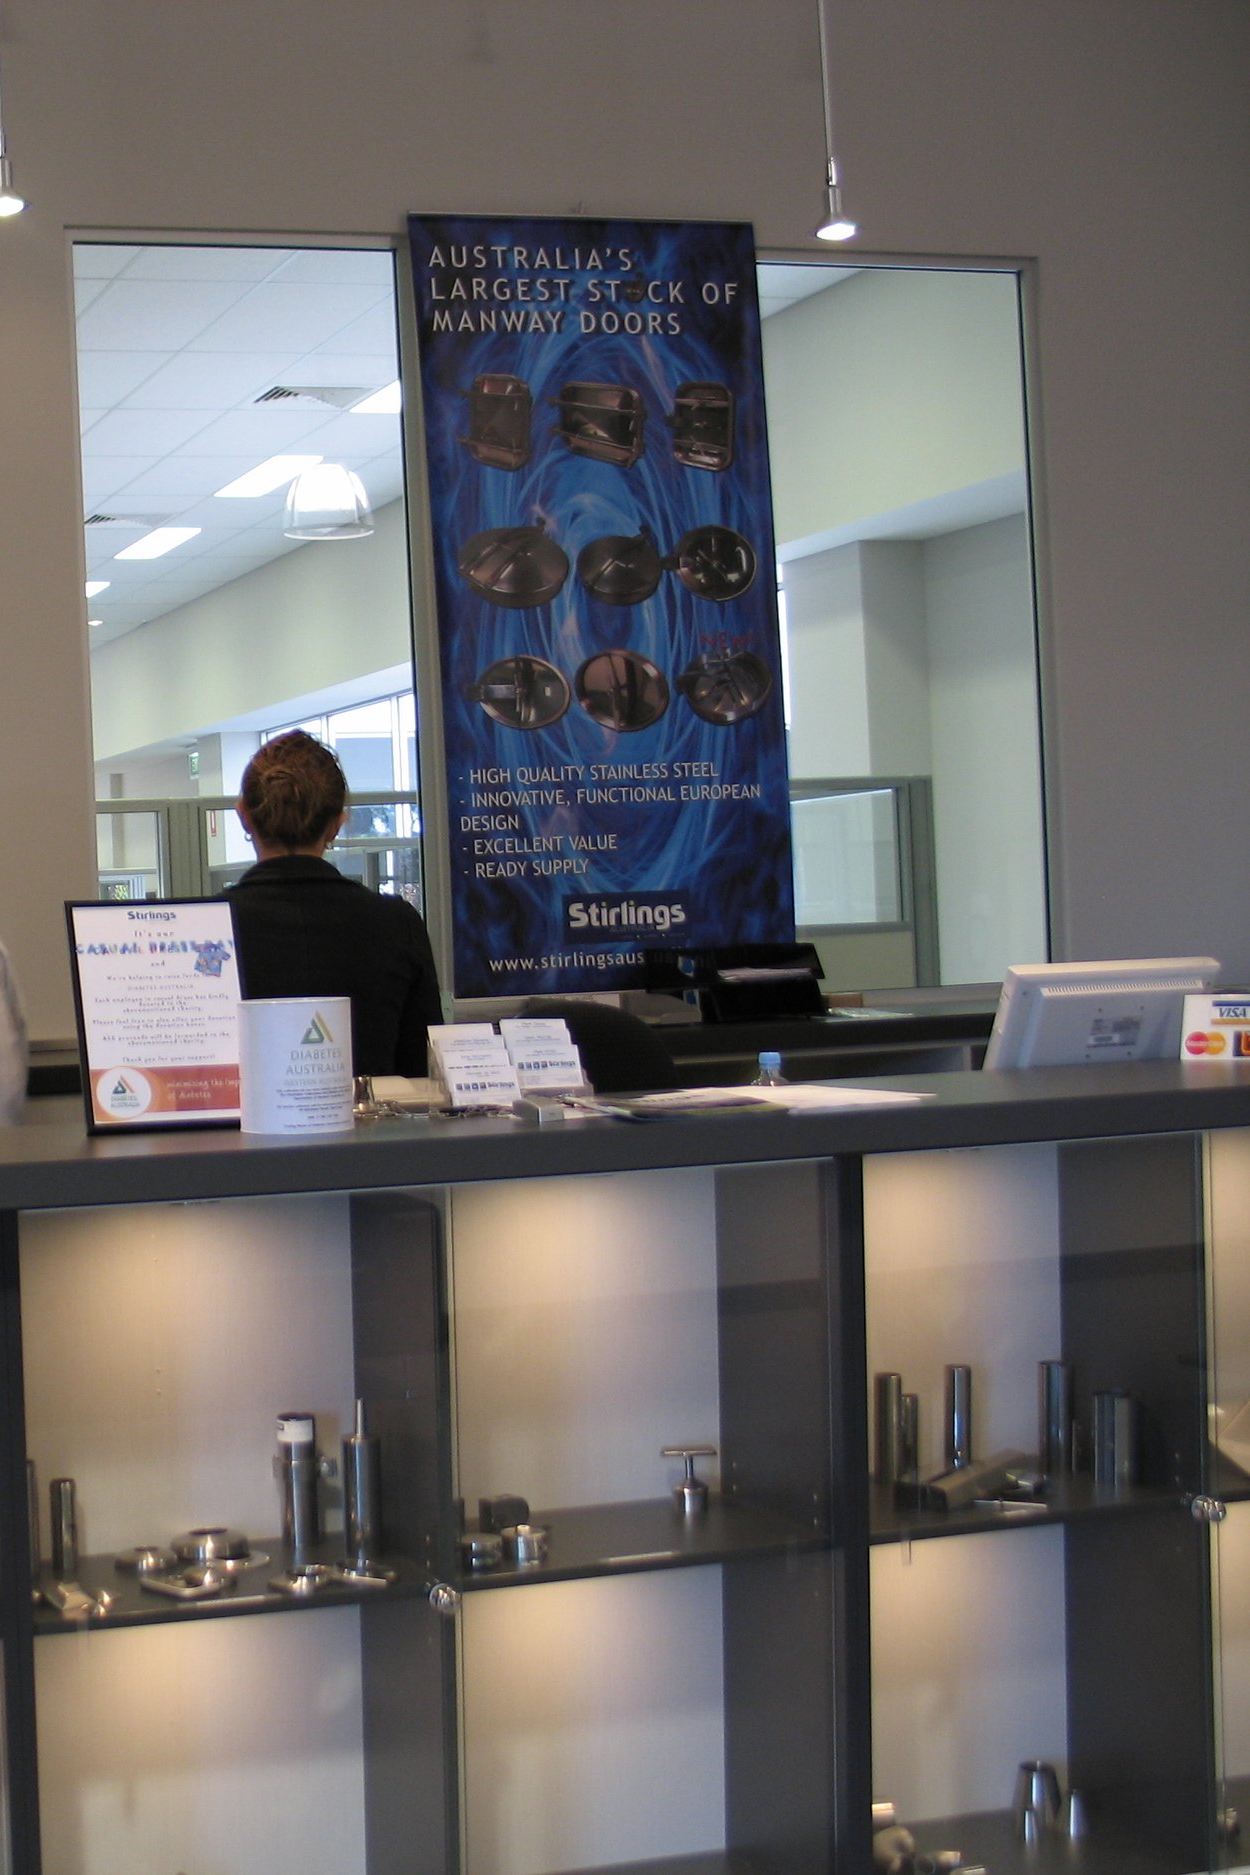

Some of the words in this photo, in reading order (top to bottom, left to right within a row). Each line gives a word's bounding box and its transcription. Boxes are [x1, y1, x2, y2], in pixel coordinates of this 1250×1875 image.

[429, 246, 633, 272] AUSTRALIA'S
[430, 279, 570, 301] LARGEST
[702, 283, 738, 305] OF
[433, 310, 565, 333] MANWAY
[580, 312, 681, 335] DOORS
[470, 769, 511, 783] HIGH
[516, 766, 585, 783] QUALITY
[589, 763, 668, 781] STAINLESS
[673, 762, 718, 778] STEEL
[471, 790, 571, 808] INNOVATIVE,
[577, 787, 675, 803] FUNCTIONAL
[681, 784, 761, 800] EUROPEAN
[461, 816, 519, 831] DESIGN
[474, 836, 563, 854] EXCELLENT
[568, 834, 617, 850] VALUE
[475, 862, 527, 878] READY
[532, 859, 589, 876] SUPPLY
[127, 911, 176, 921] Stirlings
[568, 900, 686, 930] Stirlings
[489, 951, 645, 972] www.stirlingsaus
[1219, 1008, 1246, 1017] VISA
[286, 1063, 345, 1075] AUSTRALIA
